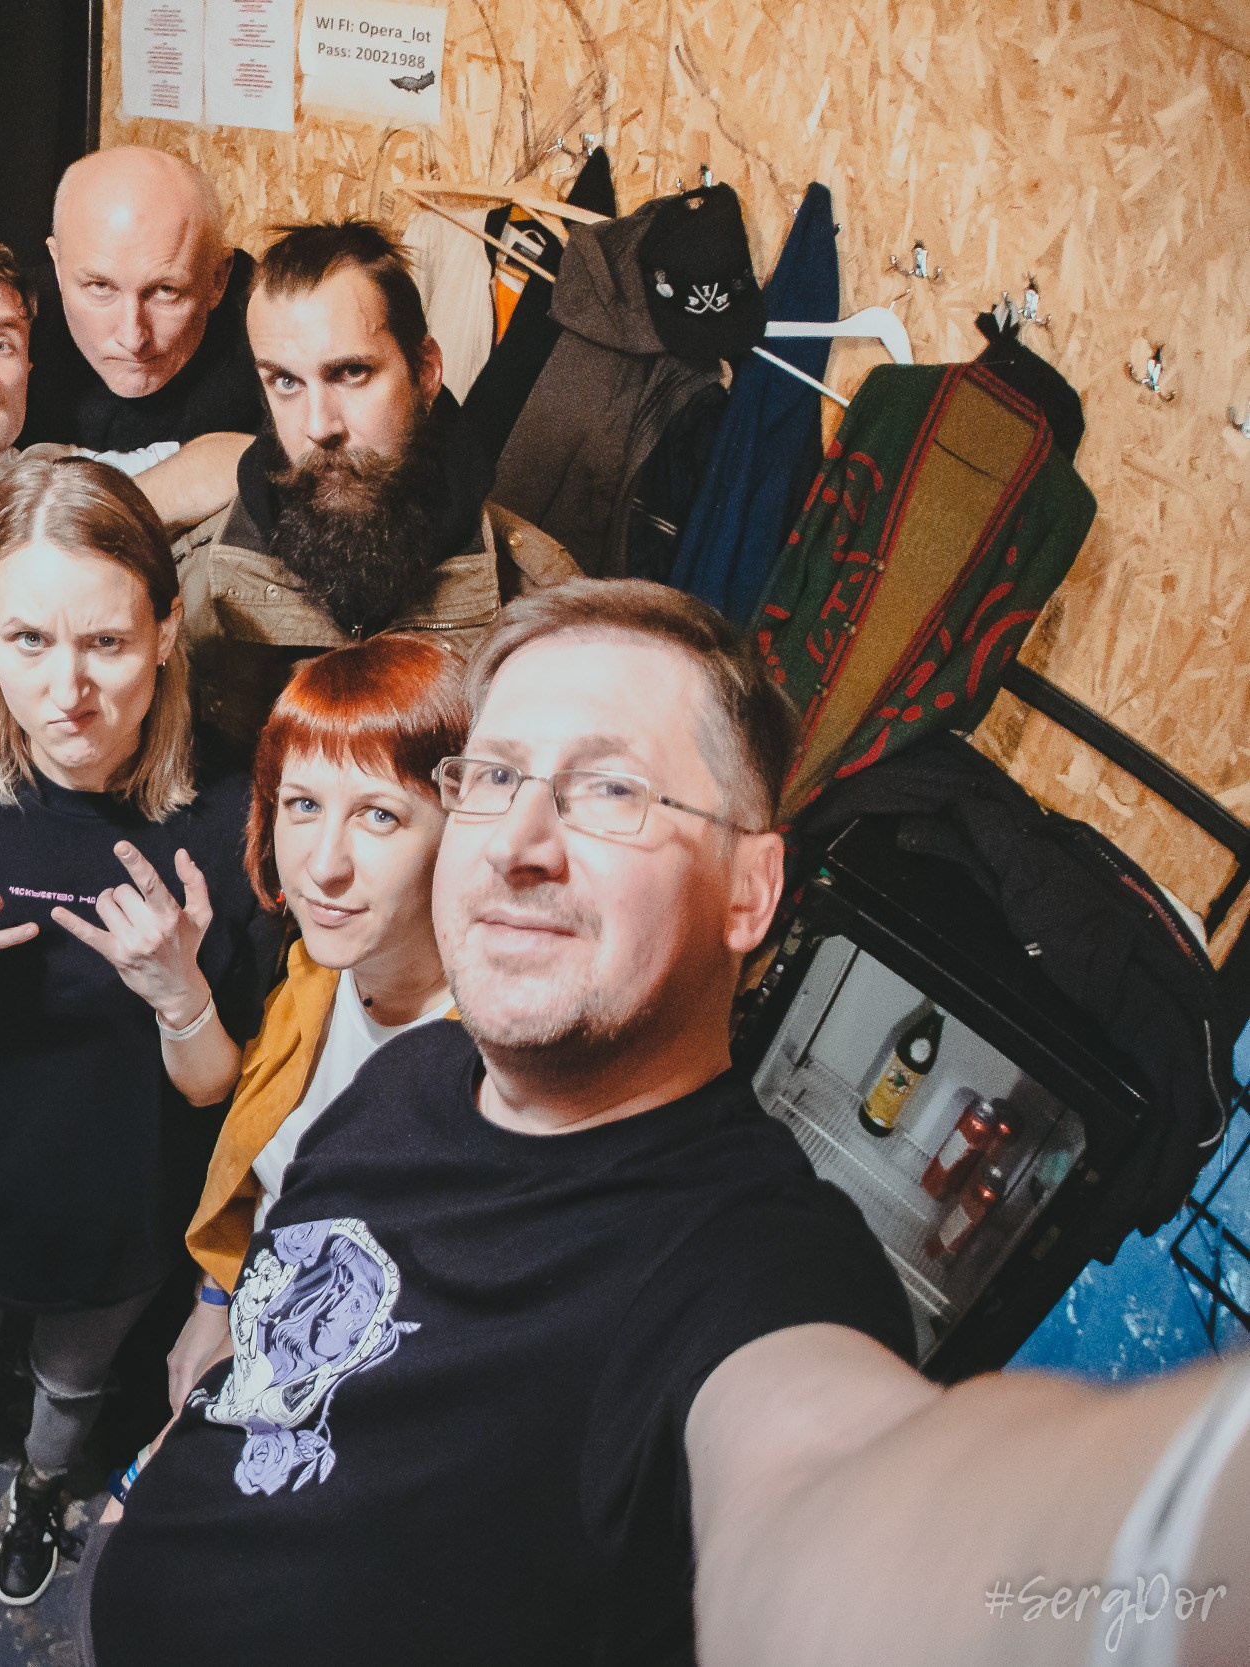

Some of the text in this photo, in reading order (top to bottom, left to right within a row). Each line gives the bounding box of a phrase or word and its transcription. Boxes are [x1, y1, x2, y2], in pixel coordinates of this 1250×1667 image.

[316, 16, 334, 30] WI
[359, 21, 431, 43] Opera_lot
[317, 42, 426, 69] Pass: 20021988
